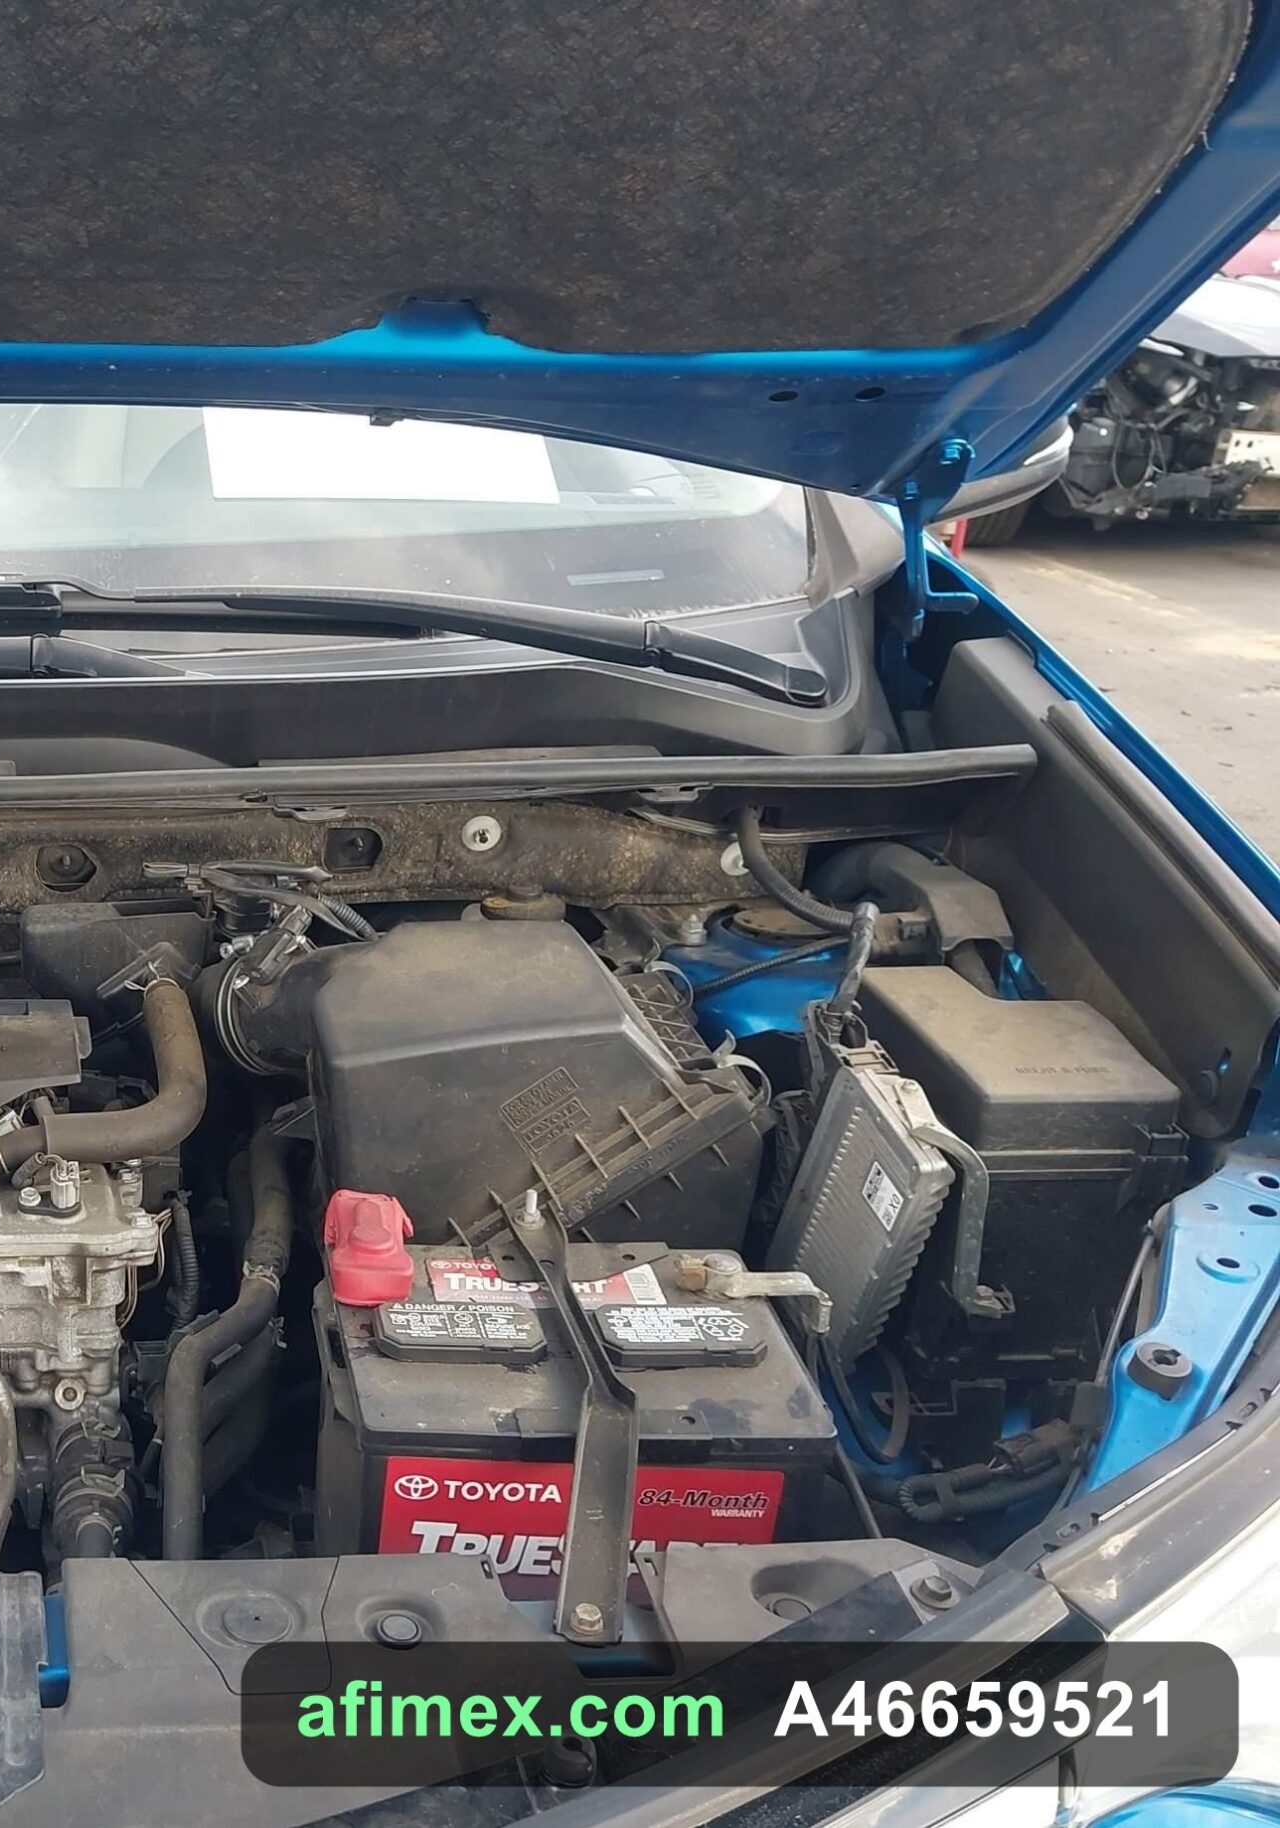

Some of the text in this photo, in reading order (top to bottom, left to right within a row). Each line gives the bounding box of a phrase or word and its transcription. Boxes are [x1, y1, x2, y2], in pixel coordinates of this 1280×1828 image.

[405, 1303, 455, 1312] DANGER
[468, 1305, 515, 1313] POISON
[443, 1479, 562, 1503] TOYOTA
[638, 1489, 770, 1509] 84-Month
[711, 1508, 765, 1518] WARRANTY
